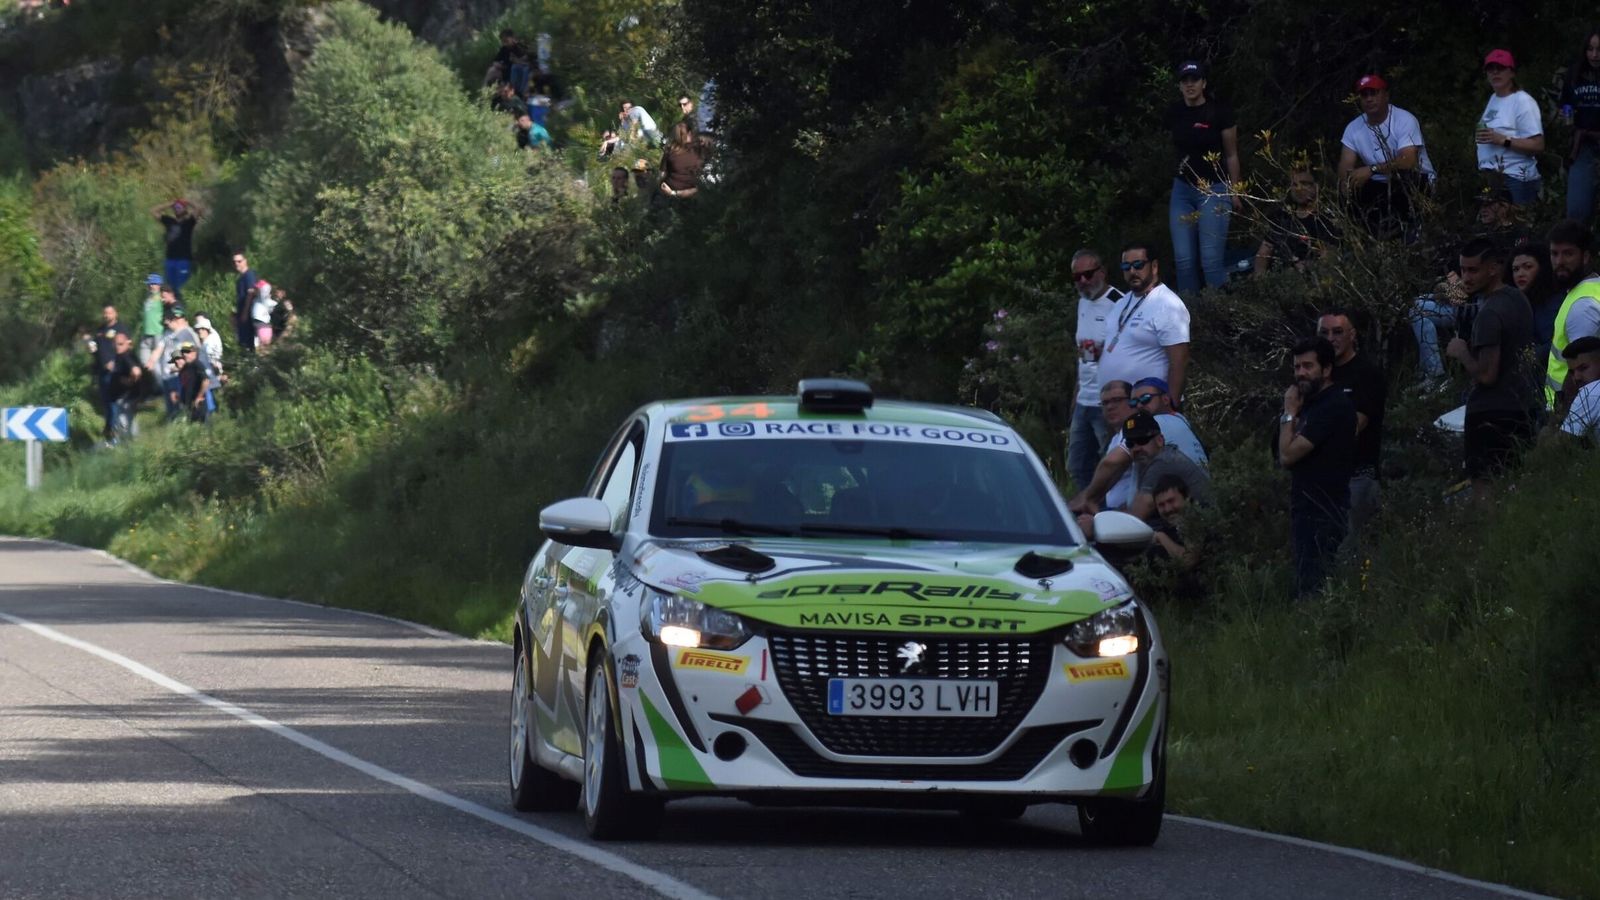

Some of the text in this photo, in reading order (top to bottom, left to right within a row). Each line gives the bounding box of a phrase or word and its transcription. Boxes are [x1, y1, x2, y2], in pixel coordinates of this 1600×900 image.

[686, 402, 775, 421] 34
[765, 421, 1010, 446] RACE FOR GOOD
[799, 612, 1026, 632] MAVISA SPORT
[680, 651, 744, 672] PIRELLI
[1068, 661, 1125, 679] PIRELLI
[850, 684, 925, 712] 3993
[936, 685, 991, 712] LVH
